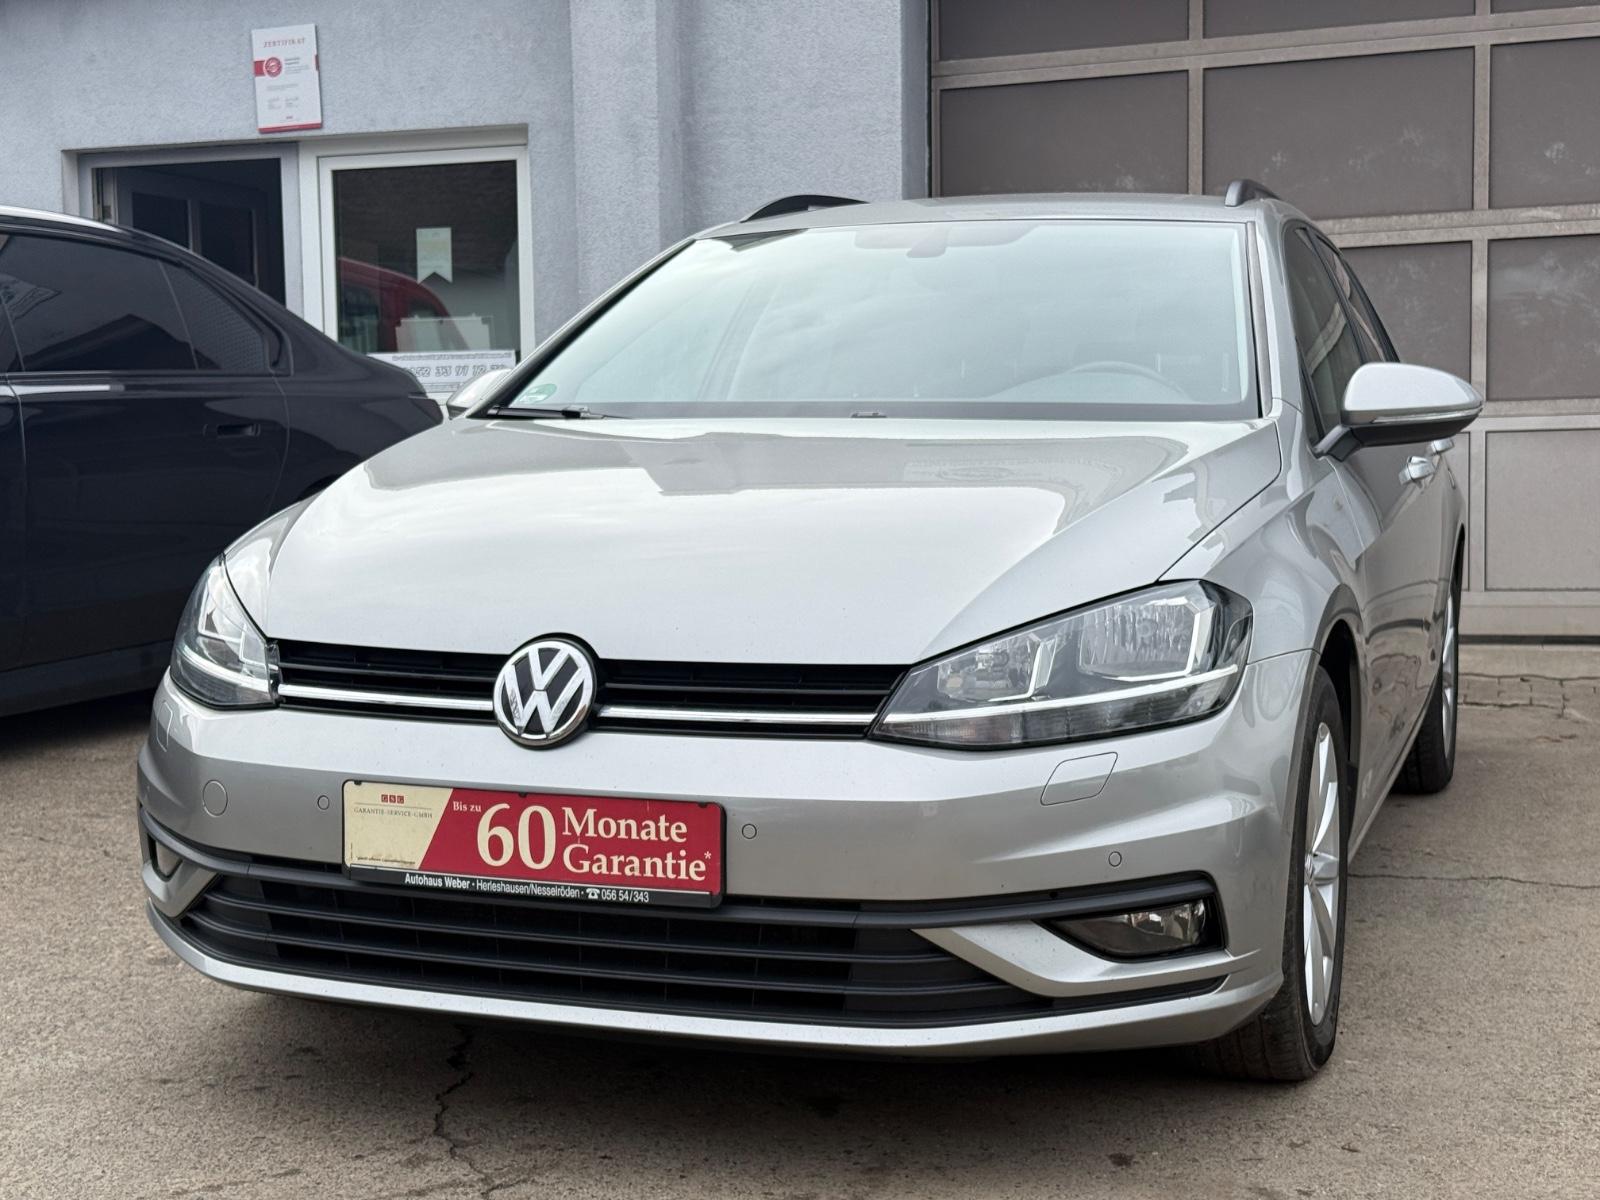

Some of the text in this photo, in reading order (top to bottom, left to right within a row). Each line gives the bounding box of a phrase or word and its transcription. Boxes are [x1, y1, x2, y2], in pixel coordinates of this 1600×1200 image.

[263, 38, 306, 48] ZERTIFIKAT
[498, 642, 592, 741] VW
[452, 801, 688, 870] Bis zu 60 Monate
[404, 872, 442, 887] Autohaus
[444, 876, 470, 889] Weber
[601, 891, 617, 901] 056
[618, 892, 650, 903] 54/343
